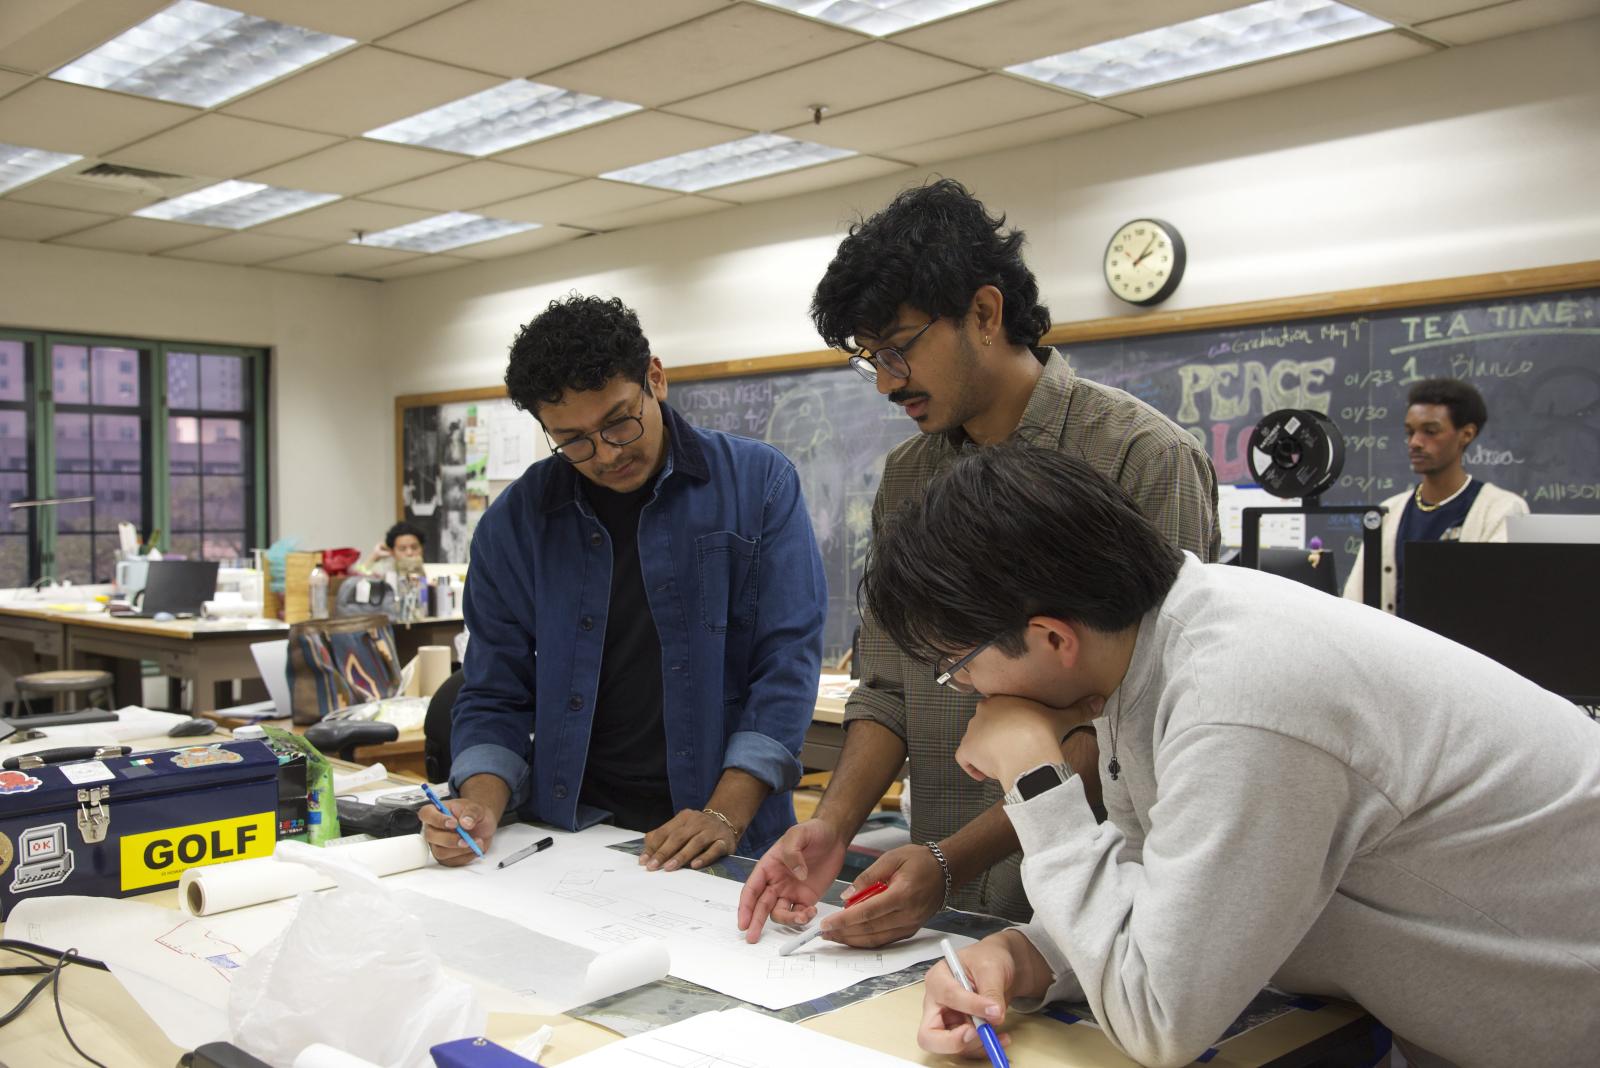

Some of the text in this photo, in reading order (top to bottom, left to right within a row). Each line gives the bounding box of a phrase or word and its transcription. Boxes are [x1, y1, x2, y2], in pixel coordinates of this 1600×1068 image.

[1320, 323, 1348, 348] May
[1400, 313, 1470, 342] TEA
[1344, 369, 1394, 389] 01/23
[1450, 353, 1534, 381] Blanco
[1177, 357, 1336, 424] PEACE
[1340, 405, 1388, 424] 01/30
[1340, 474, 1394, 493] 02/13
[32, 840, 51, 852] OK
[143, 824, 258, 870] GOLF
